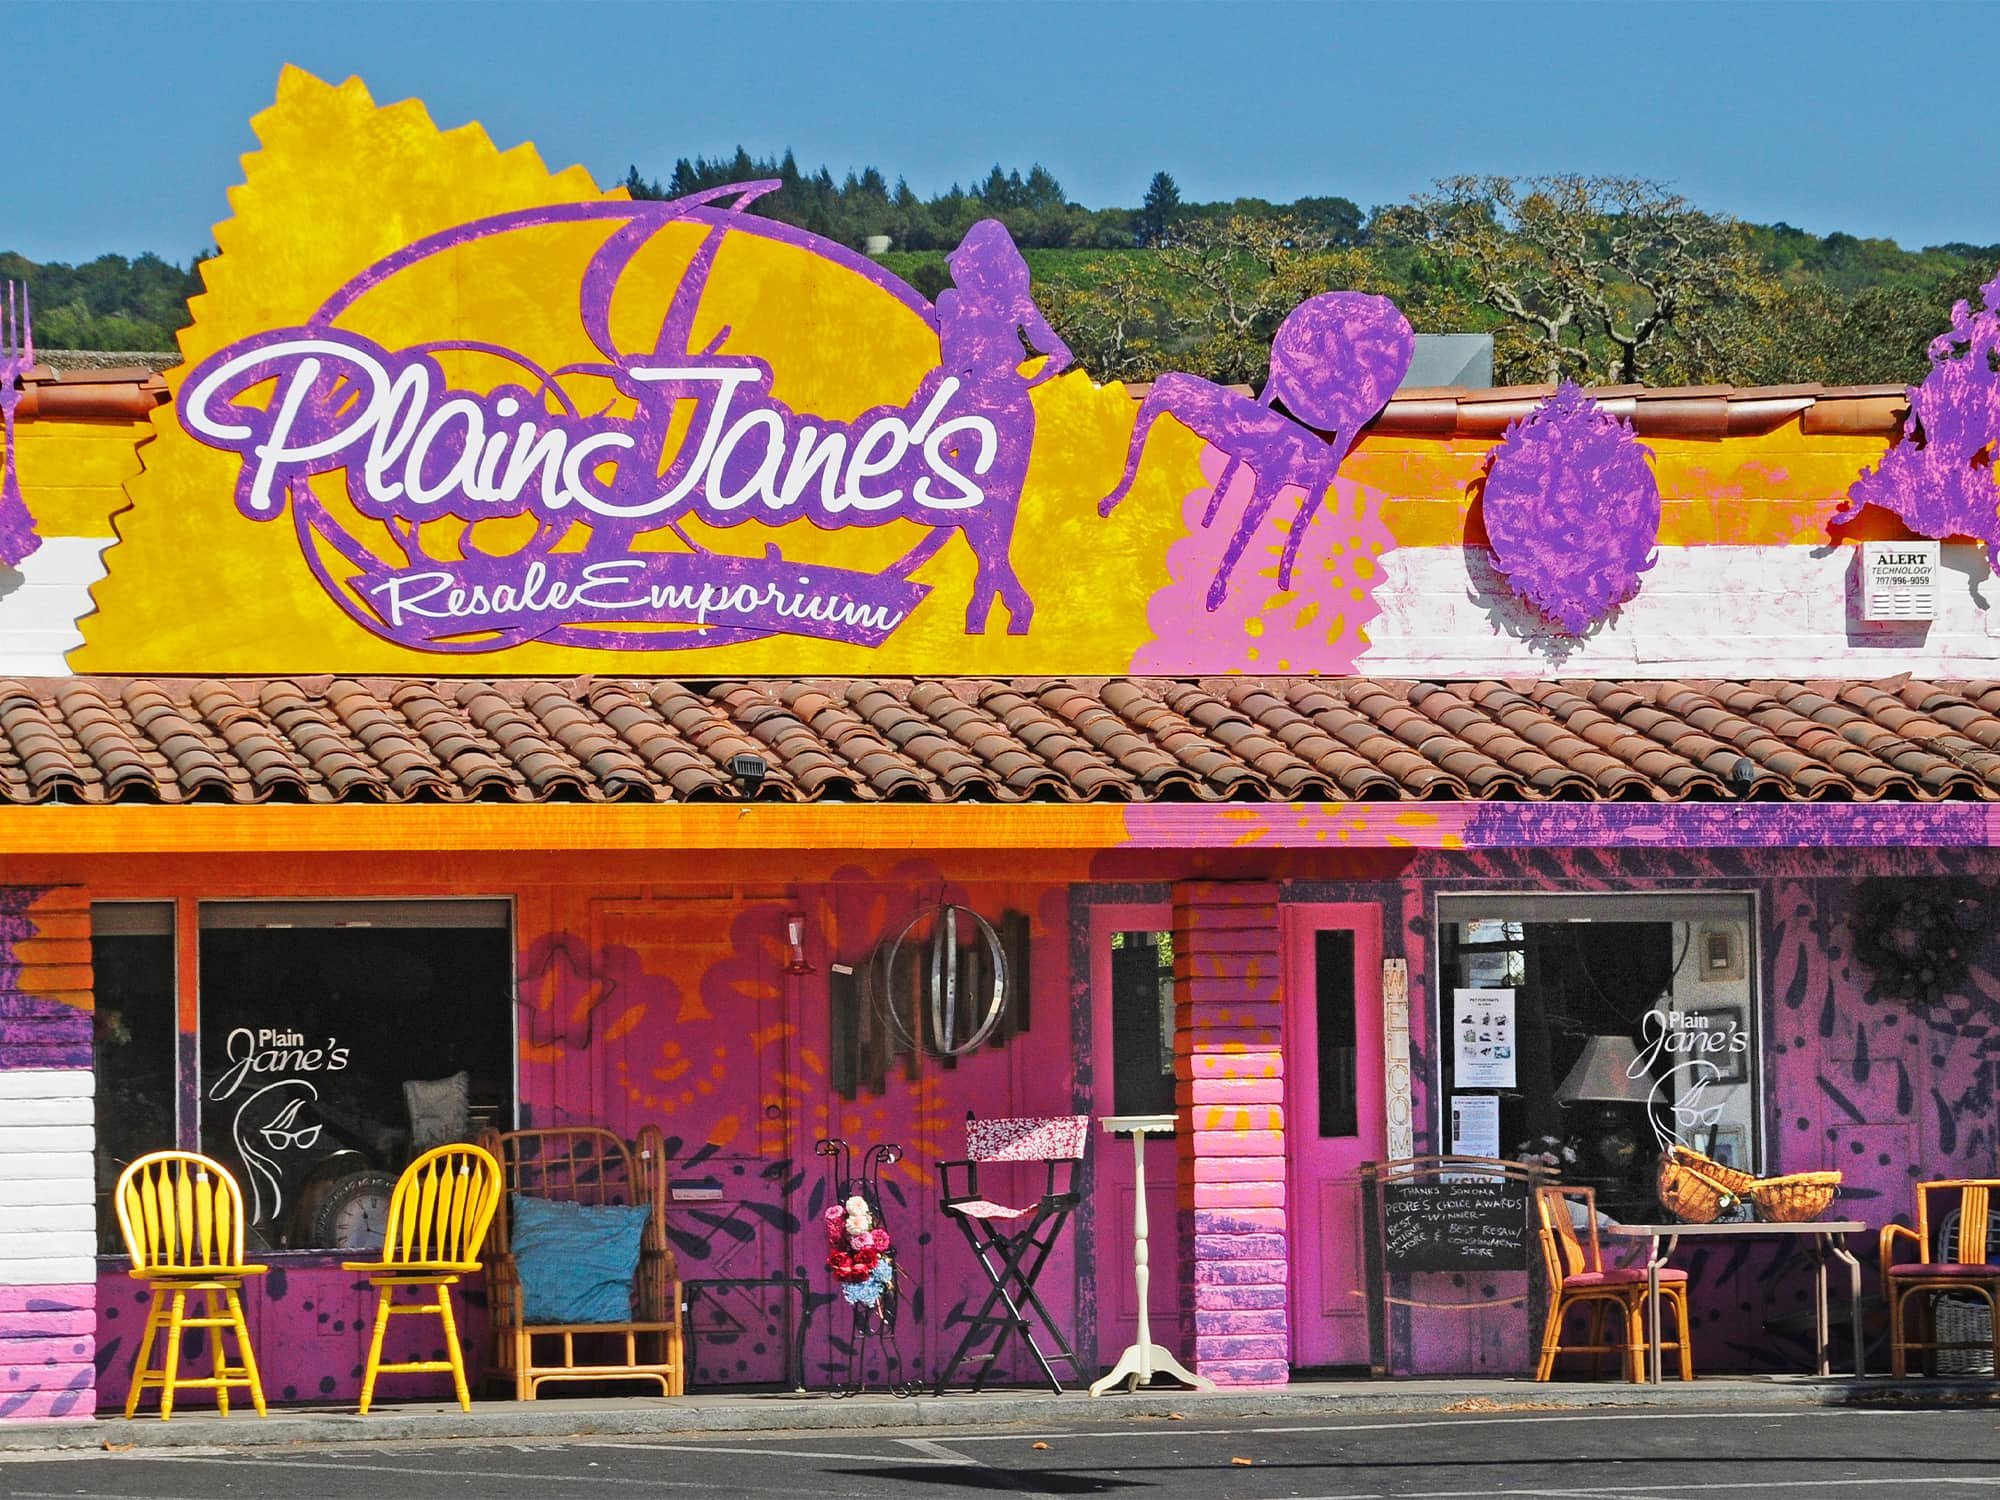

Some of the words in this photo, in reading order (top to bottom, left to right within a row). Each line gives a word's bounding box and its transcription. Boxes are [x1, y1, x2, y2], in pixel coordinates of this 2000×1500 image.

[186, 340, 564, 511] Plain
[563, 367, 997, 518] Jane's
[1877, 554, 1928, 565] ALERT
[1871, 566, 1933, 575] TECHNOLOGY
[370, 562, 580, 626] Resale
[573, 560, 903, 636] Emporium
[1669, 1011, 1709, 1029] Plain
[258, 1028, 304, 1048] Plain
[1626, 1010, 1751, 1080] Jane's
[208, 1027, 350, 1101] Jane's
[1384, 969, 1414, 1173] WELCOM
[1398, 1186, 1440, 1198] THANKS
[1436, 1199, 1471, 1211] CHOICE
[1475, 1197, 1522, 1210] AWARDS
[1387, 1215, 1412, 1236] BEST
[1448, 1223, 1478, 1235] BEST
[1385, 1223, 1424, 1252] ANTIQUE
[1394, 1231, 1428, 1258] STORE
[1460, 1245, 1495, 1258] STORE
